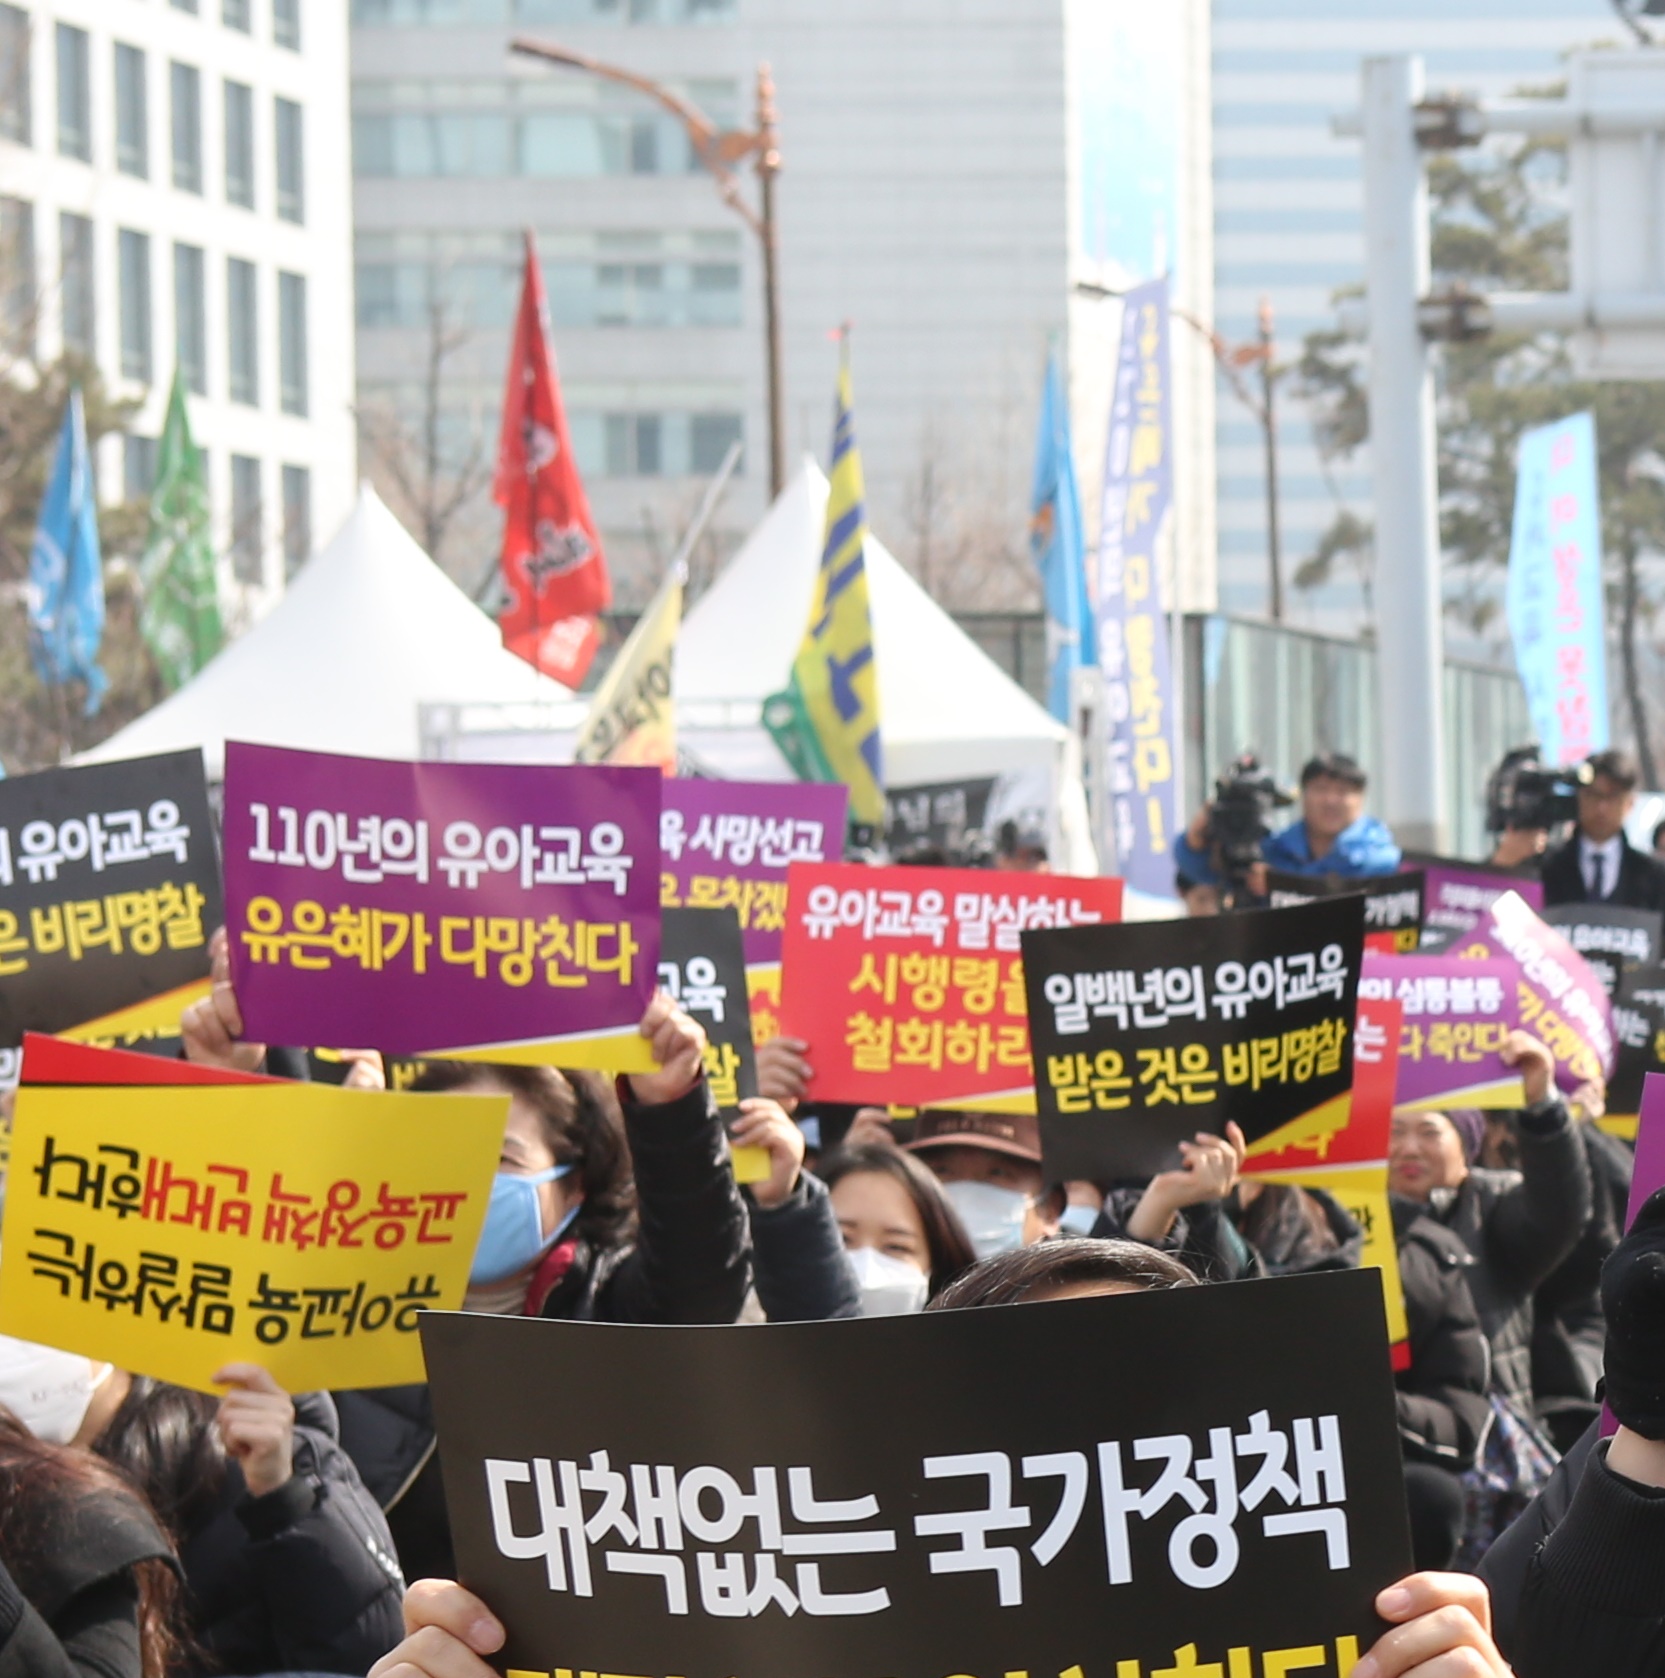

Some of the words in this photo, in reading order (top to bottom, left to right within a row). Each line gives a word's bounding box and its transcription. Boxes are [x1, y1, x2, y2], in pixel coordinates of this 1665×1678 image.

[18, 799, 191, 884] 유아교육
[248, 802, 430, 885] 110년의
[437, 819, 635, 896] 유아교육
[688, 813, 825, 867] 사망선고
[30, 880, 206, 961] 비리명찰
[240, 896, 432, 974] 유은혜가
[440, 915, 640, 988] 다망친다
[802, 885, 949, 949] 유아교육
[1044, 965, 1206, 1036] 일백년의
[1211, 943, 1349, 1020] 유아교육
[1047, 1048, 1132, 1113] 받은
[1136, 1043, 1218, 1108] 것은
[1222, 1017, 1347, 1091] 비리명찰
[32, 1136, 253, 1237] 반대한다
[262, 1172, 468, 1252] 교육정책
[26, 1229, 236, 1336] 말살하는
[484, 1448, 897, 1618] 대책없는
[914, 1409, 1352, 1608] 국가정책
